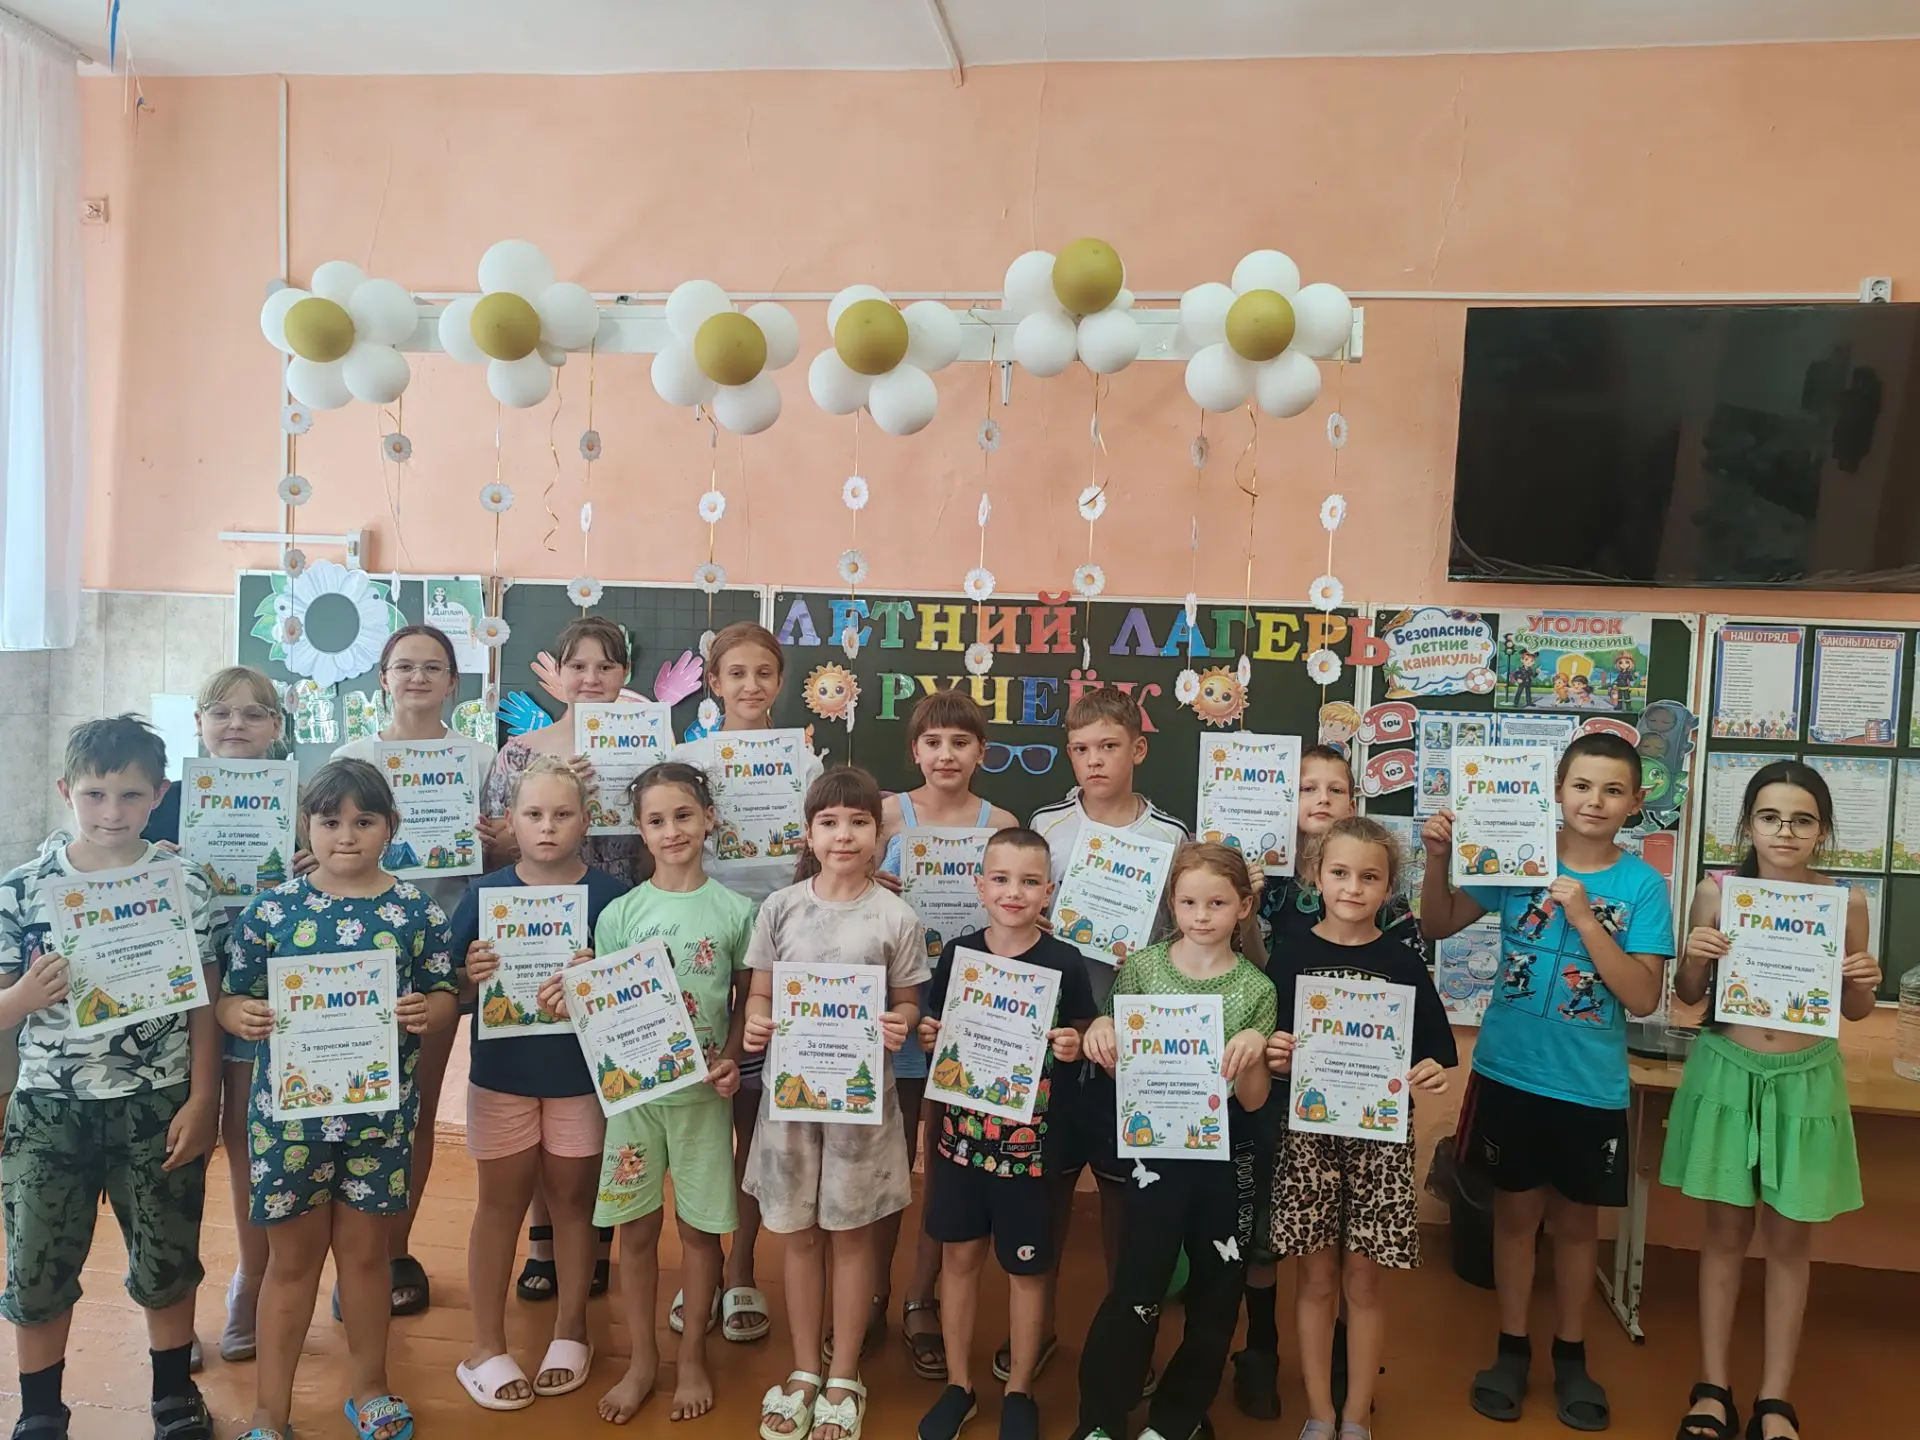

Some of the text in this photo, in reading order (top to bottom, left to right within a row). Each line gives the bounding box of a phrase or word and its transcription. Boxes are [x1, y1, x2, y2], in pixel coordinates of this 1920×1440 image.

[778, 591, 1390, 666] ЛЕТНИЙ ЛАГЕРЬ
[1527, 615, 1623, 635] УГОЛОК
[1393, 625, 1484, 645] Безопасные
[1513, 628, 1634, 650] безопасности
[1730, 632, 1789, 643] НАШ ОТРЯД
[1410, 639, 1469, 656] летние
[1821, 637, 1898, 649] ЗАКОНЫ ЛАГЕРЯ
[1403, 654, 1483, 671] каникулы
[1382, 720, 1400, 728] 104
[591, 735, 657, 748] ГРАМОТА
[725, 762, 792, 778] ГРАМОТА
[1215, 767, 1285, 784] ГРАМОТА
[1385, 767, 1403, 777] 103
[393, 772, 464, 787] ГРАМОТА
[1468, 781, 1540, 794] ГРАМОТА
[201, 795, 280, 810] ГРАМОТА
[440, 815, 460, 823] друзей
[1483, 820, 1518, 828] спортивный
[916, 862, 983, 875] ГРАМОТА
[1086, 854, 1151, 884] ГРАМОТА
[73, 897, 172, 929] ГРАМОТА
[497, 922, 572, 938] ГРАМОТА
[662, 924, 680, 937] all
[1739, 913, 1826, 936] ГРАМОТА
[96, 951, 106, 960] За
[108, 938, 163, 958] ответственность
[119, 950, 153, 964] старание
[1746, 957, 1755, 966] За
[1757, 961, 1792, 971] творческий
[504, 963, 512, 971] За
[290, 990, 379, 1012] ГРАМОТА
[585, 978, 662, 1015] ГРАМОТА
[963, 987, 1037, 1019] ГРАМОТА
[791, 1001, 868, 1020] ГРАМОТА
[606, 1018, 666, 1044] За яркие открытия
[1312, 1018, 1395, 1041] ГРАМОТА
[301, 1043, 310, 1051] За
[313, 1041, 349, 1052] творческий
[621, 1030, 656, 1048] этого лета
[808, 1040, 816, 1049] За
[963, 1028, 1022, 1050] За яркие открытия
[799, 1050, 835, 1059] настроение
[973, 1042, 1008, 1056] этого лета
[1132, 1039, 1209, 1055] ГРАМОТА
[1315, 1067, 1343, 1077] участнику
[1325, 1058, 1380, 1072] Самому активному
[1147, 1079, 1167, 1088] Самому
[1138, 1089, 1166, 1097] участнику
